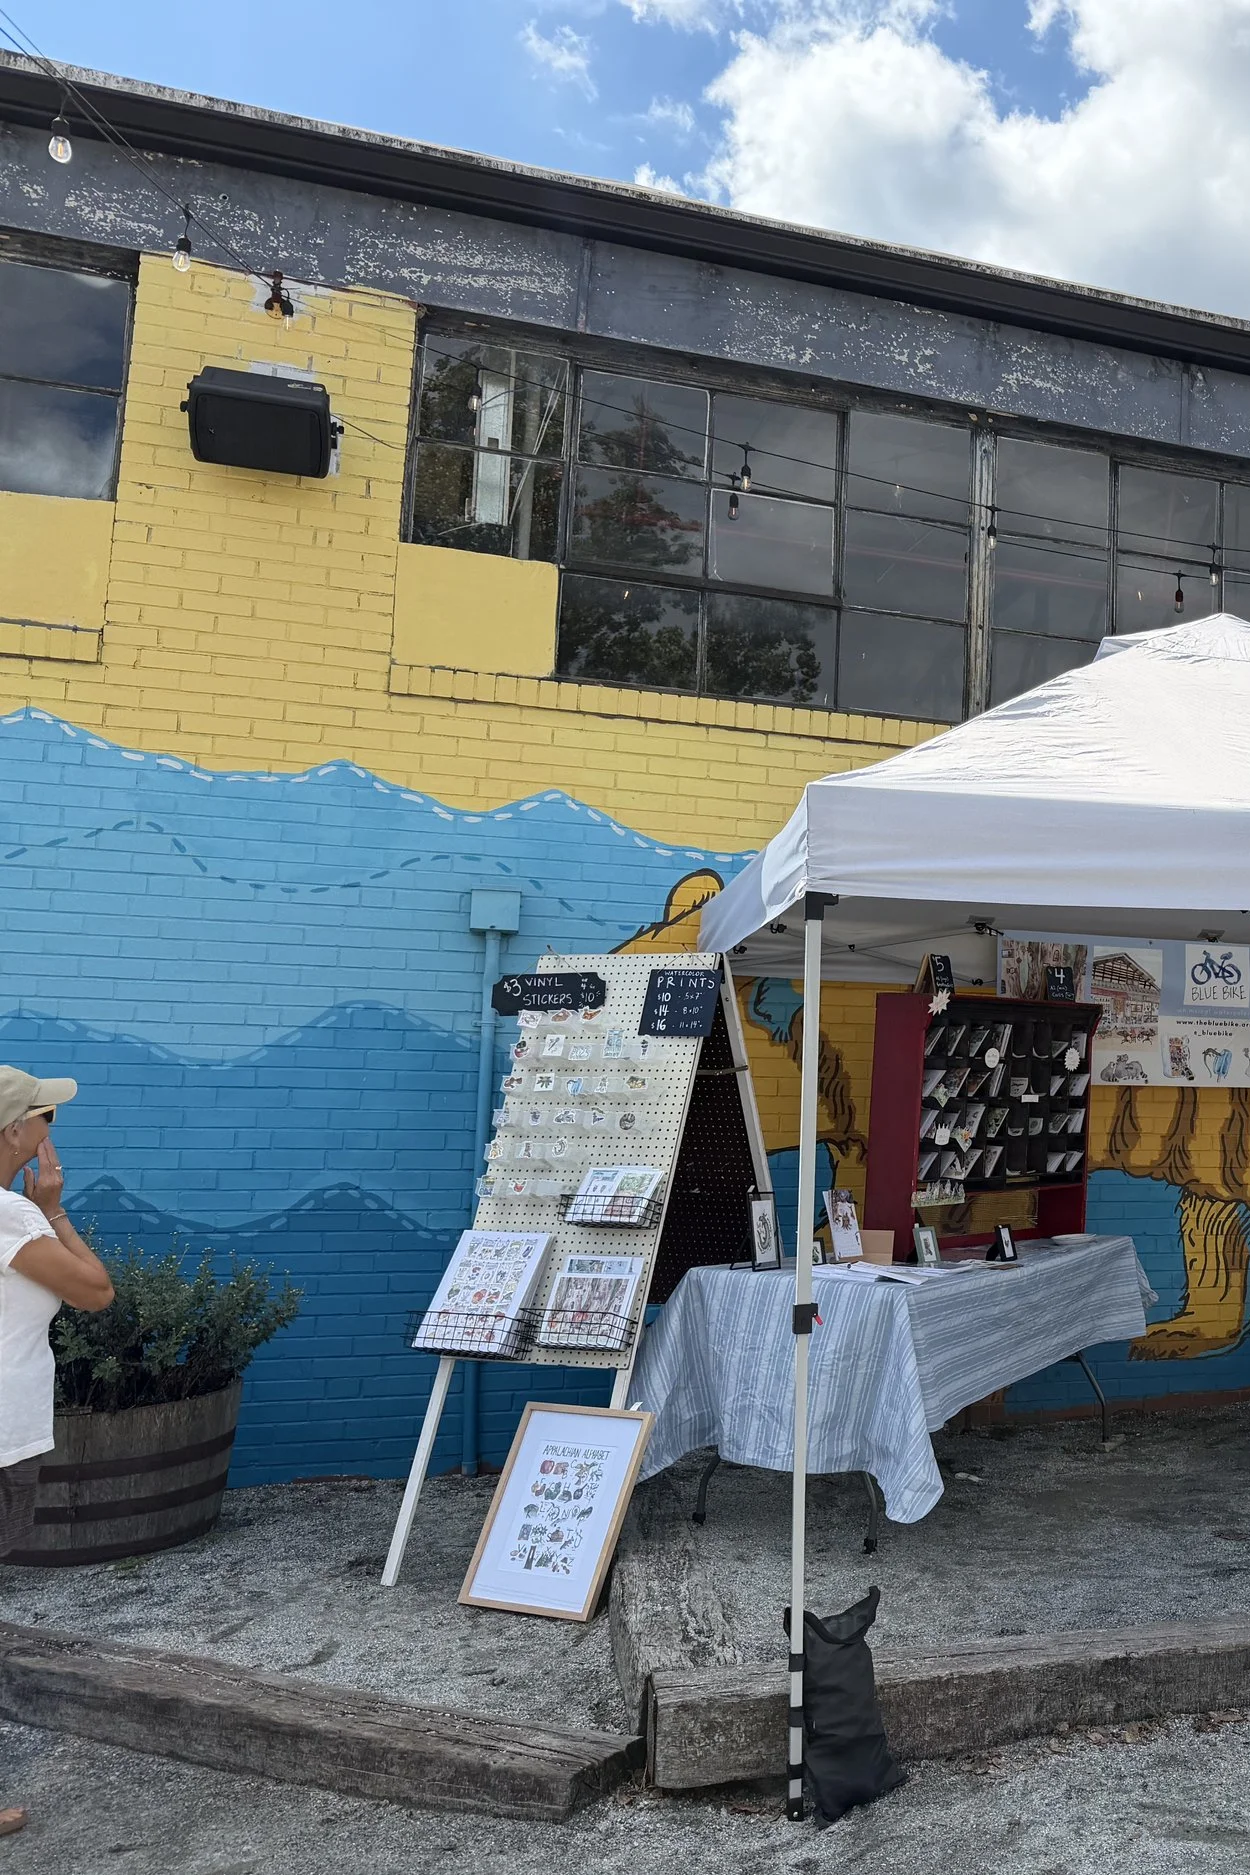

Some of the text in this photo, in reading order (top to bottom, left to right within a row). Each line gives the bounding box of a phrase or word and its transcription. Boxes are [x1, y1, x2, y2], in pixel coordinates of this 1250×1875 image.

[503, 977, 563, 997] $3 VINYL
[657, 976, 715, 989] PRINTS
[657, 992, 672, 1002] $10
[1191, 985, 1247, 1001] BLUE BIKE
[522, 994, 573, 1006] STICKERS
[654, 1004, 670, 1016] $14
[650, 1019, 666, 1031] $16
